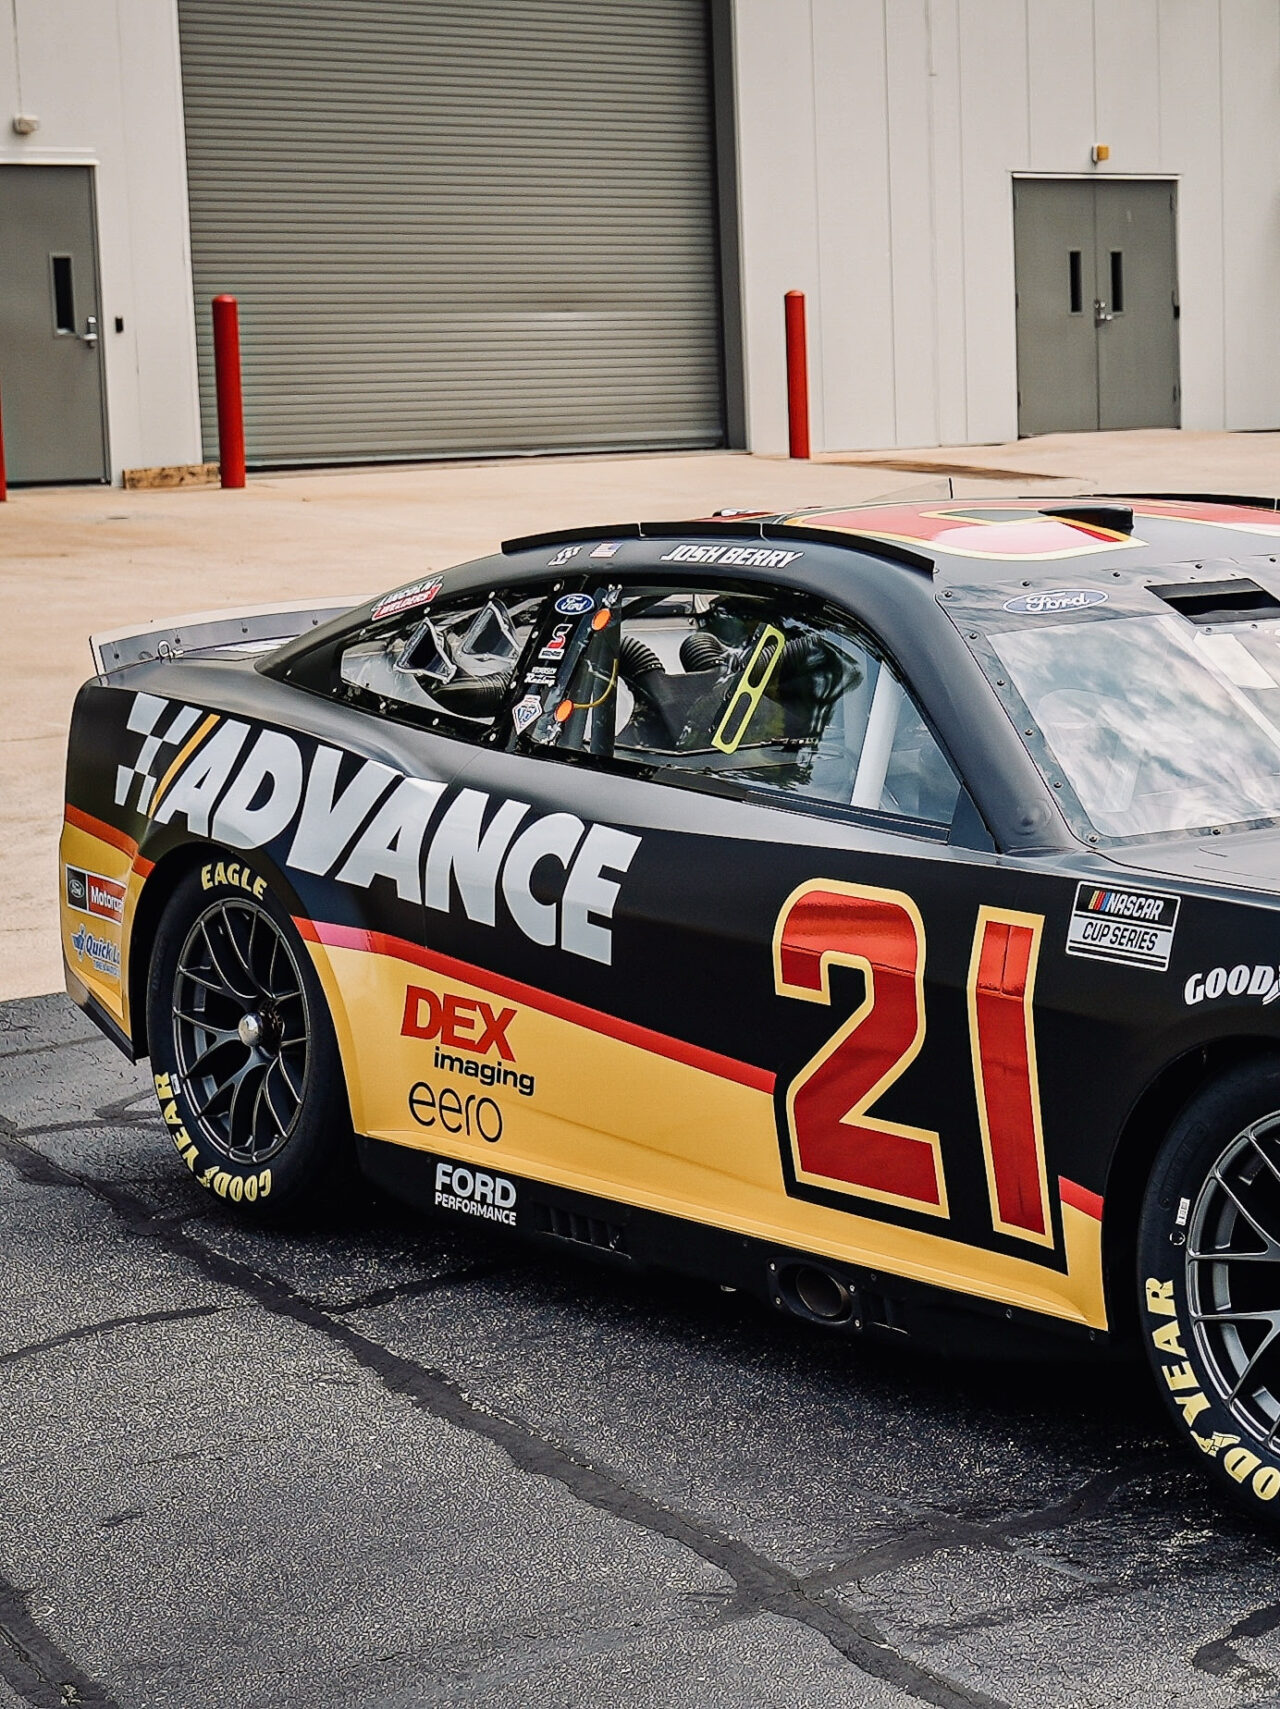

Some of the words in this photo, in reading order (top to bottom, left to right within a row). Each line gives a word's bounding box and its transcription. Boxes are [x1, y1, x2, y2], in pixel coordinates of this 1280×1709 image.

[660, 544, 722, 563] JOSH
[718, 546, 804, 568] BERRY
[560, 595, 588, 611] Ford
[1022, 590, 1095, 612] Ford
[153, 716, 642, 966] ADVANCE
[201, 861, 268, 901] EAGLE
[1105, 891, 1165, 921] NASCAR
[85, 934, 114, 959] Quick
[1081, 921, 1111, 943] CUP
[1111, 926, 1159, 952] SERIES
[400, 984, 518, 1063] DEX
[433, 1045, 535, 1097] imaging
[772, 877, 1055, 1251] 21
[408, 1081, 503, 1143] eero
[434, 1162, 517, 1209] FORD
[434, 1191, 517, 1227] PERFORMANCE
